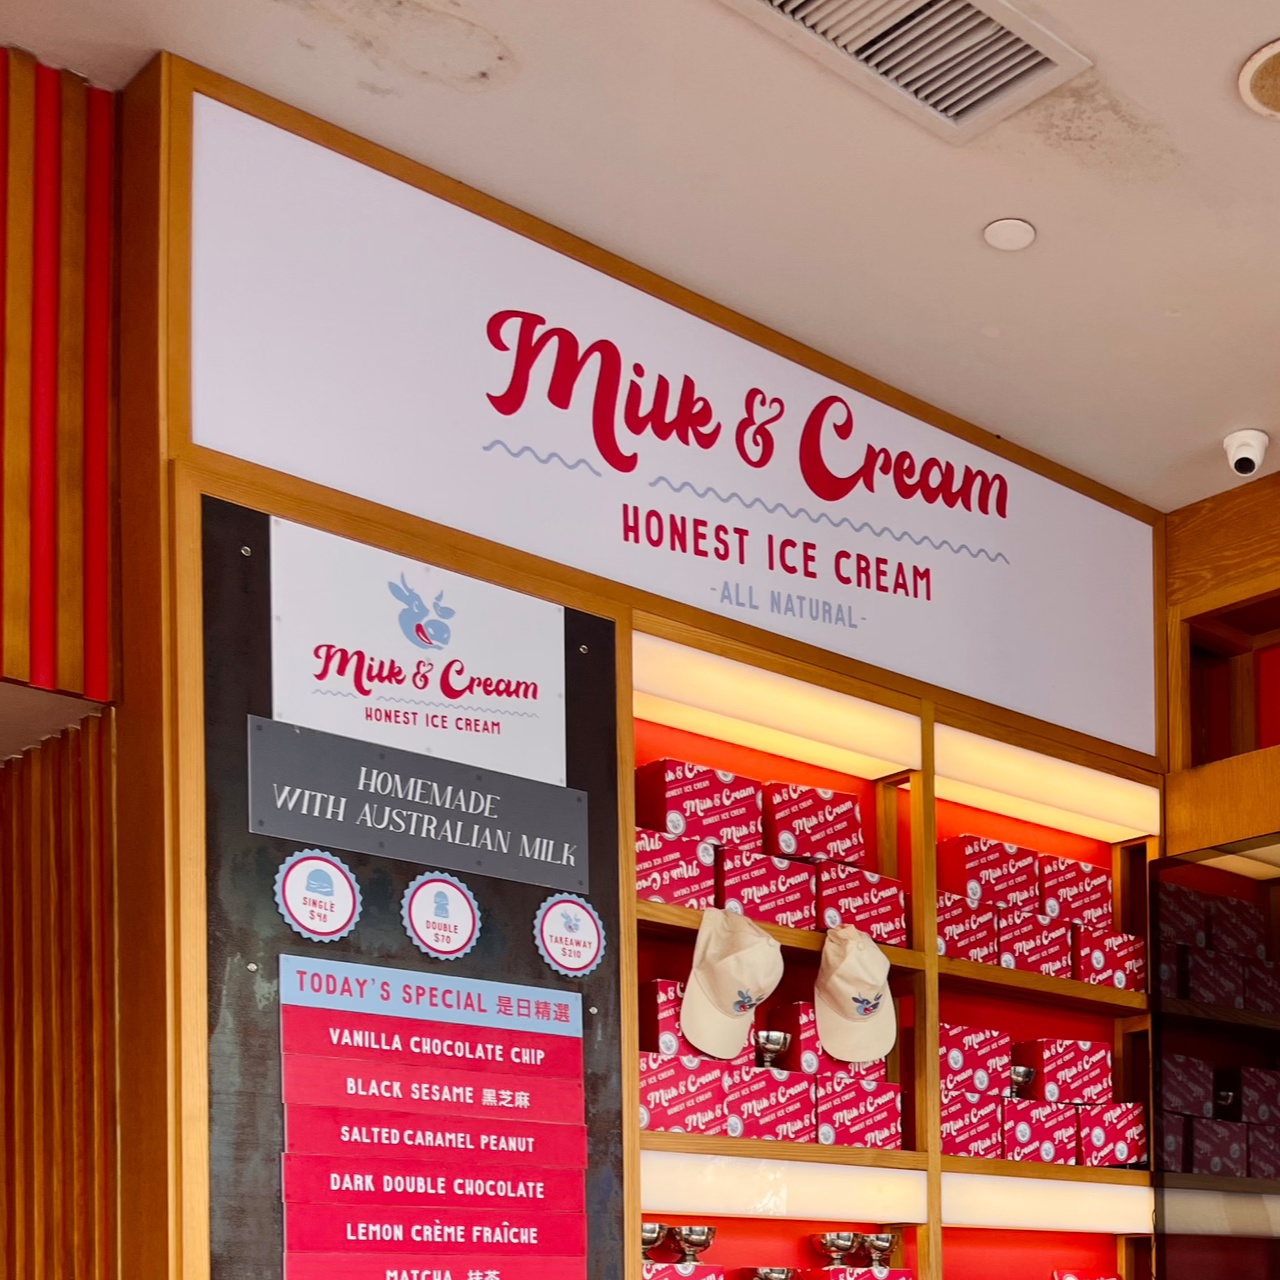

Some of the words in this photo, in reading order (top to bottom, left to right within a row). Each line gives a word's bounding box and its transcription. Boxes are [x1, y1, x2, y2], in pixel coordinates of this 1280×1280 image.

[486, 310, 721, 473] Milk
[735, 387, 784, 467] &
[799, 396, 1007, 518] Cream
[623, 504, 749, 564] HONEST
[768, 534, 817, 578] ICE
[834, 550, 931, 601] CREAM
[313, 644, 407, 696] Milk
[412, 660, 433, 689] &
[440, 659, 538, 699] Cream
[365, 707, 418, 726] HONEST
[426, 713, 448, 729] ICE
[455, 716, 500, 734] CREAM
[358, 767, 500, 819] HOMEMADE
[273, 784, 346, 822] WITH
[356, 803, 510, 853] AUSTRALIAN
[519, 834, 576, 867] MILK
[303, 897, 335, 912] SINGLE
[426, 920, 458, 934] DOUBLE
[434, 932, 451, 944] $70
[550, 935, 592, 949] TAKEAWAY
[561, 947, 581, 958] $210
[402, 984, 487, 1013] SPECIAL
[496, 995, 570, 1023] 是日精選
[329, 1028, 402, 1051] VANILLA
[410, 1037, 503, 1061] CHOCOLATE
[511, 1048, 545, 1065] CHIP
[347, 1078, 402, 1099] BLACK
[411, 1083, 474, 1104] SESAME
[482, 1089, 530, 1108] 黑芝麻
[341, 1126, 400, 1144] SALTED
[403, 1130, 475, 1149] CARAMEL
[480, 1135, 534, 1152] PEANUT
[330, 1174, 375, 1191] DARK
[383, 1176, 445, 1194] DOUBLE
[453, 1179, 544, 1199] CHOCOLATE
[347, 1223, 403, 1241] LEMON
[411, 1220, 465, 1242] CRÈME
[472, 1222, 537, 1244] FRAÎCHE
